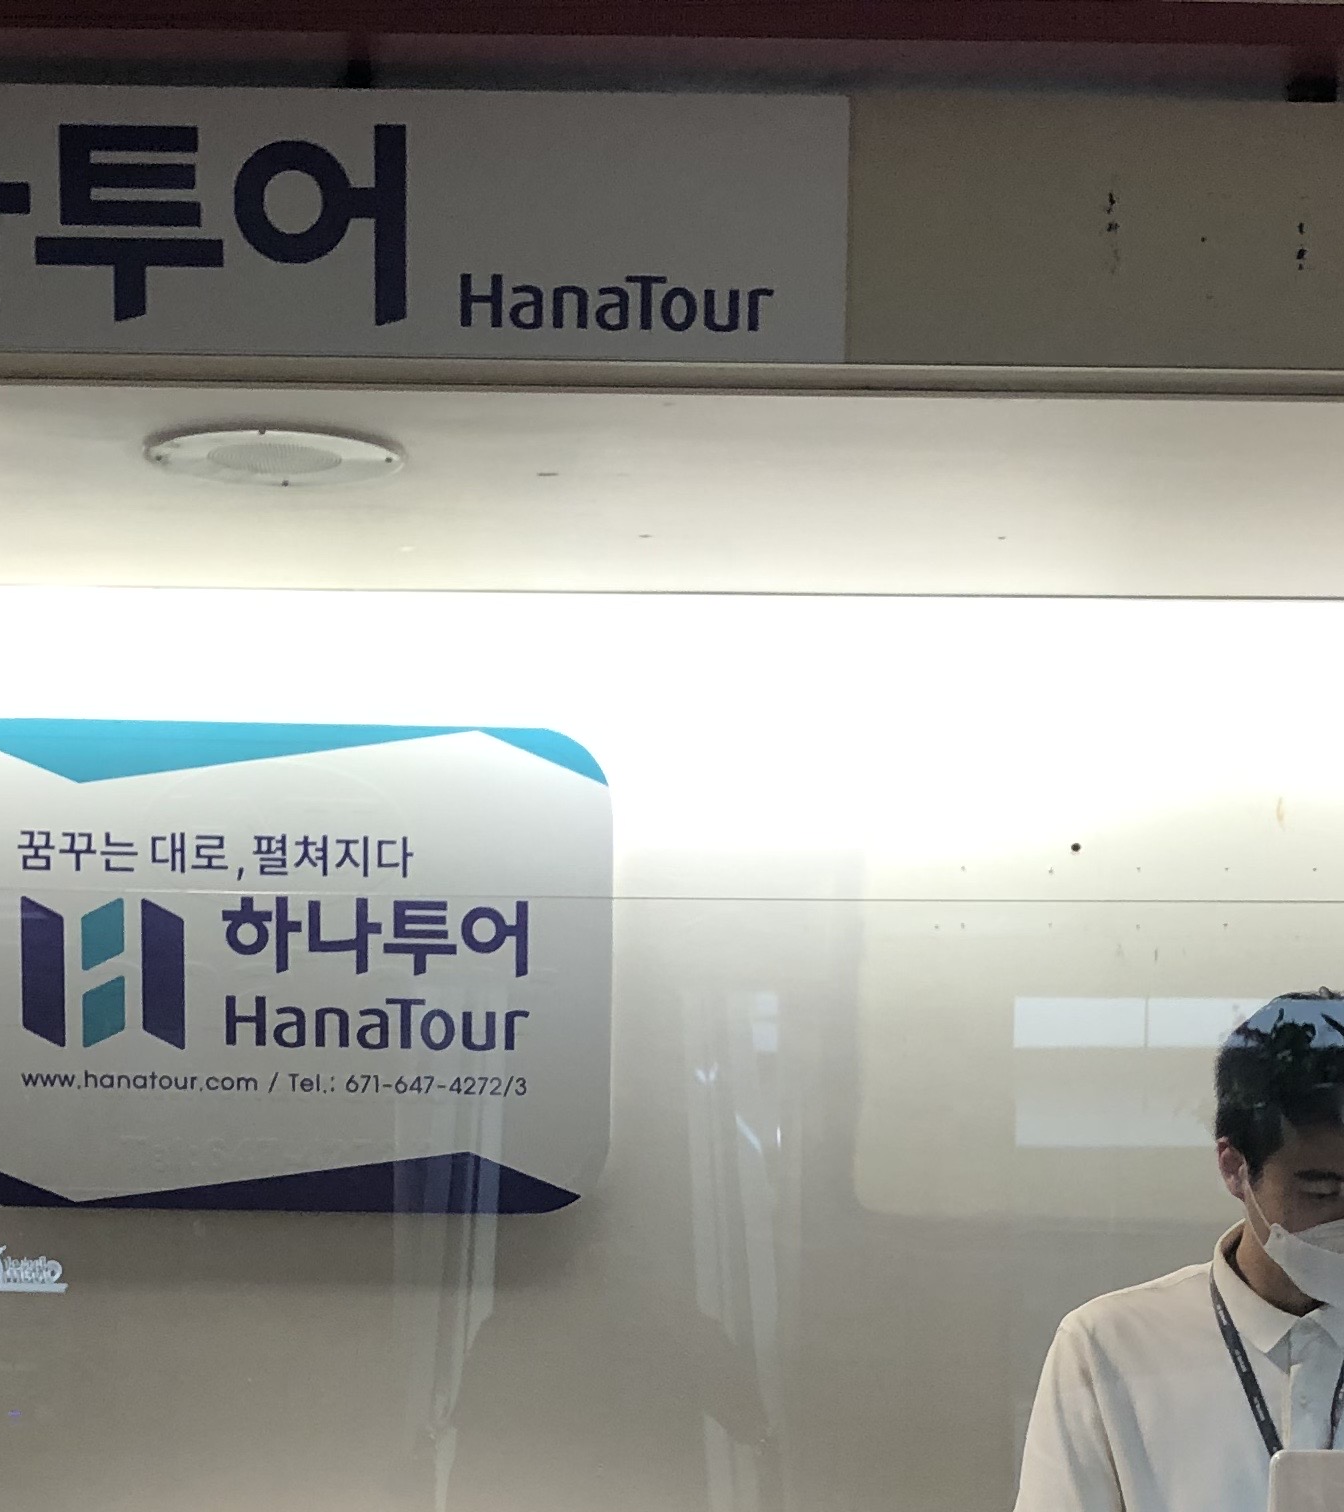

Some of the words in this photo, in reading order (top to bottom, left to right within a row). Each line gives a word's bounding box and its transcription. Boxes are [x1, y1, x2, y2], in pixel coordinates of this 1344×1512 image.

[460, 272, 774, 333] HanaTour
[17, 829, 138, 873] 꿈꾸는
[150, 832, 245, 880] 대로,
[252, 834, 414, 878] 펼쳐지다
[222, 896, 529, 977] 하나투어
[225, 996, 529, 1051] HanaTour
[21, 1070, 258, 1093] www.hanatour.com
[345, 1074, 527, 1097] 671-647-4272/3
